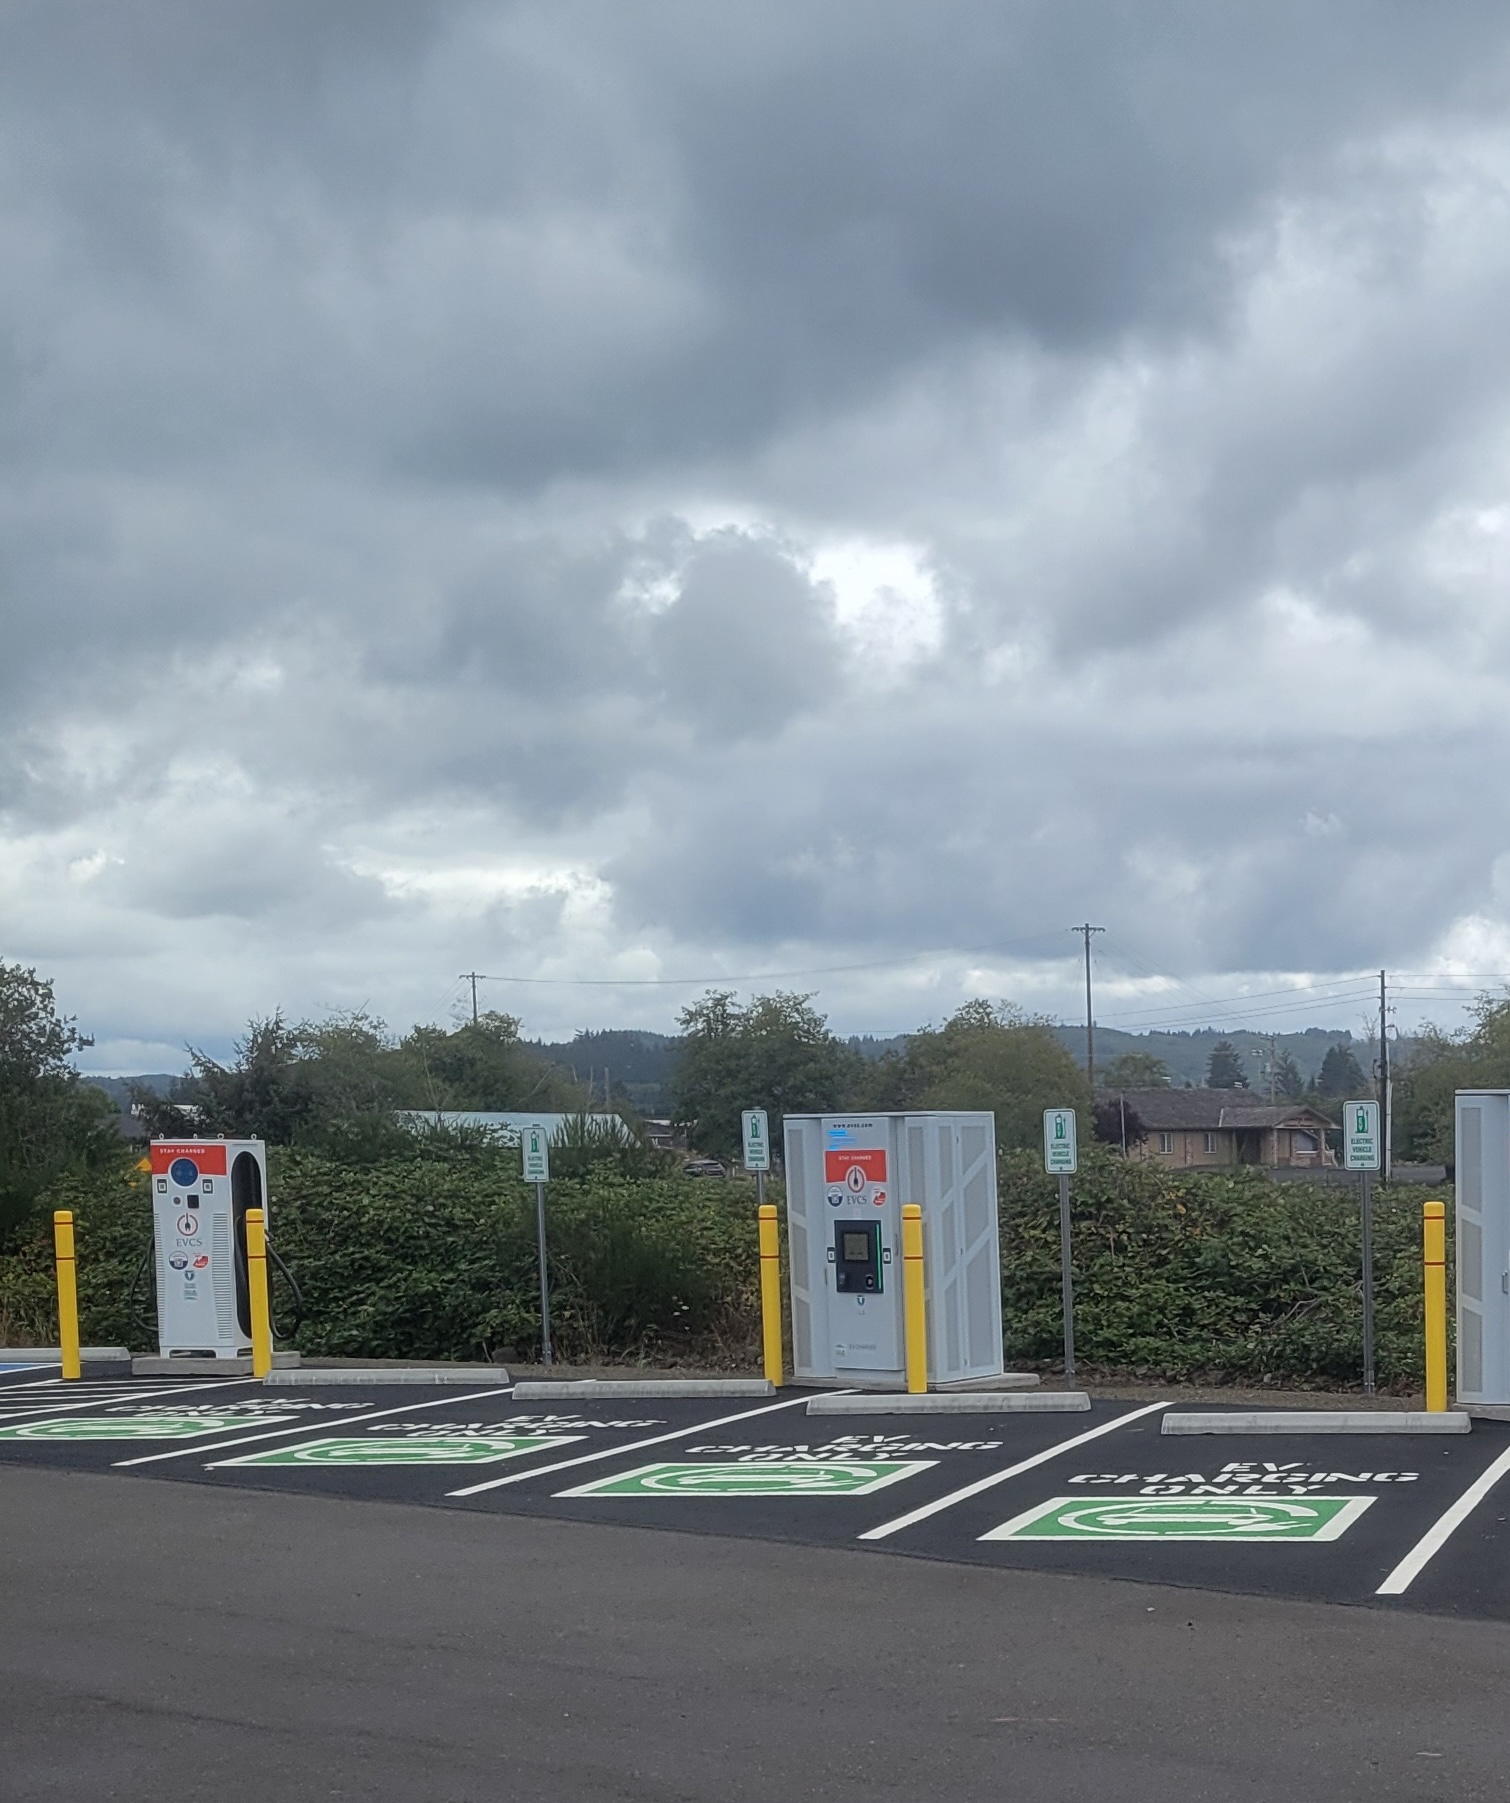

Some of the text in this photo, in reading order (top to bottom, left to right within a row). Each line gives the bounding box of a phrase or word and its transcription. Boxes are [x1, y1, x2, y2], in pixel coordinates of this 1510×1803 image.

[846, 1195, 867, 1205] EVCS
[176, 1238, 203, 1247] EVCS
[1220, 1462, 1312, 1472] EV
[1067, 1472, 1420, 1484] CHARGING
[1139, 1485, 1325, 1495] ONLY
